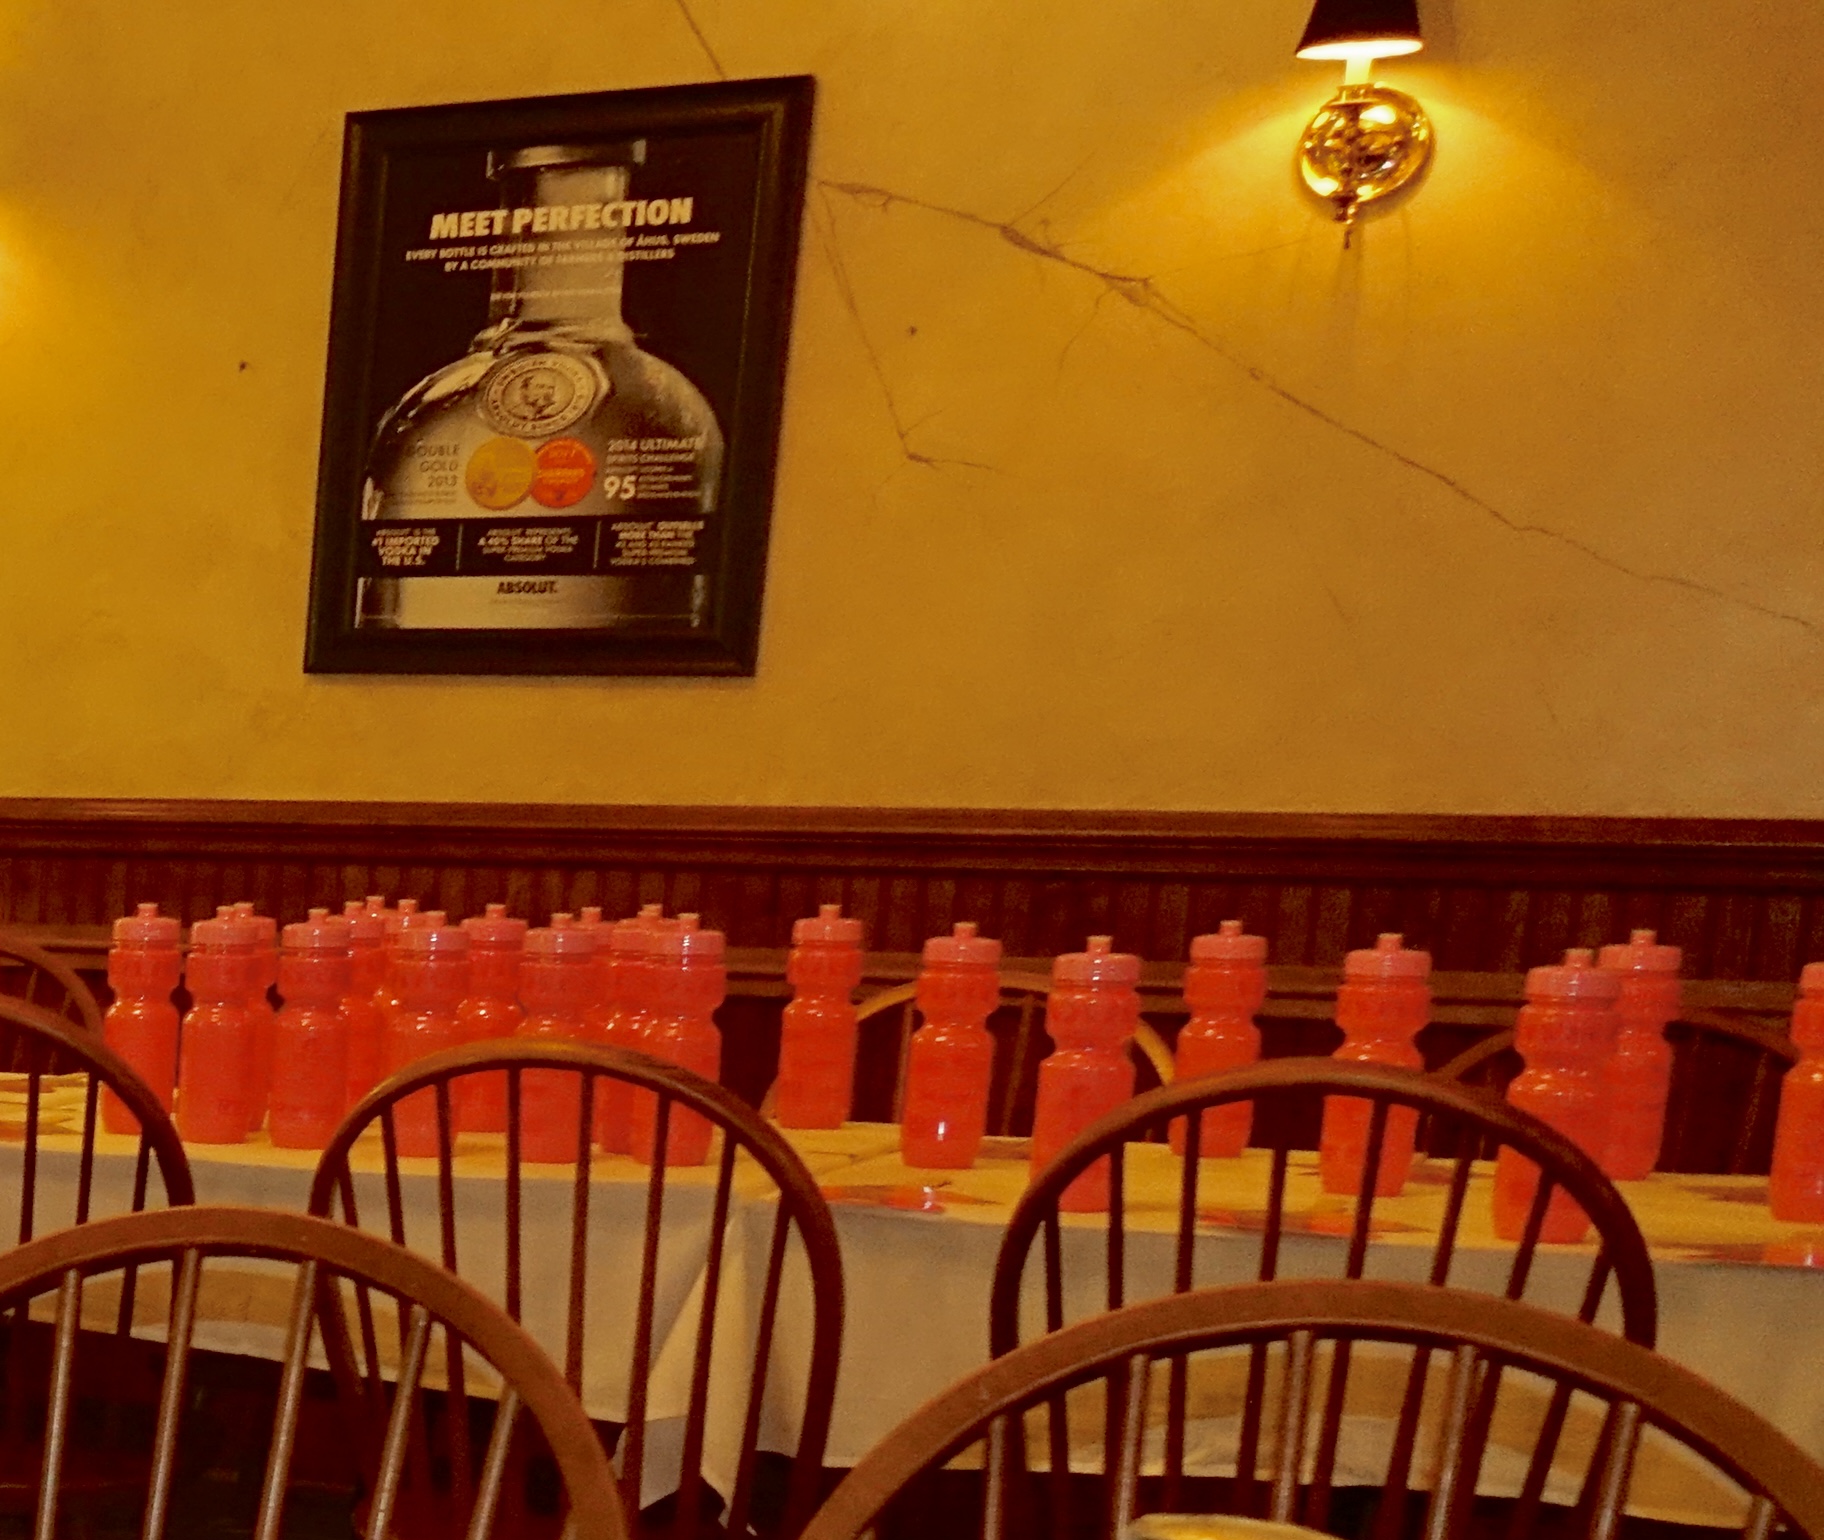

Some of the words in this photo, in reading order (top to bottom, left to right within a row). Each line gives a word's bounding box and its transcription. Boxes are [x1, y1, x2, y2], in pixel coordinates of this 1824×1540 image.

[429, 208, 509, 240] MEET
[511, 197, 694, 234] PERFECTION
[405, 248, 437, 261] EVERY
[439, 246, 476, 259] BOTTLE
[489, 243, 536, 256] CRAFTED
[673, 232, 721, 245] SWEDEN
[444, 261, 459, 272] BY
[460, 260, 469, 271] A
[470, 256, 537, 270] COMMUNITY
[419, 460, 458, 473] GOLD
[604, 475, 637, 500] 95
